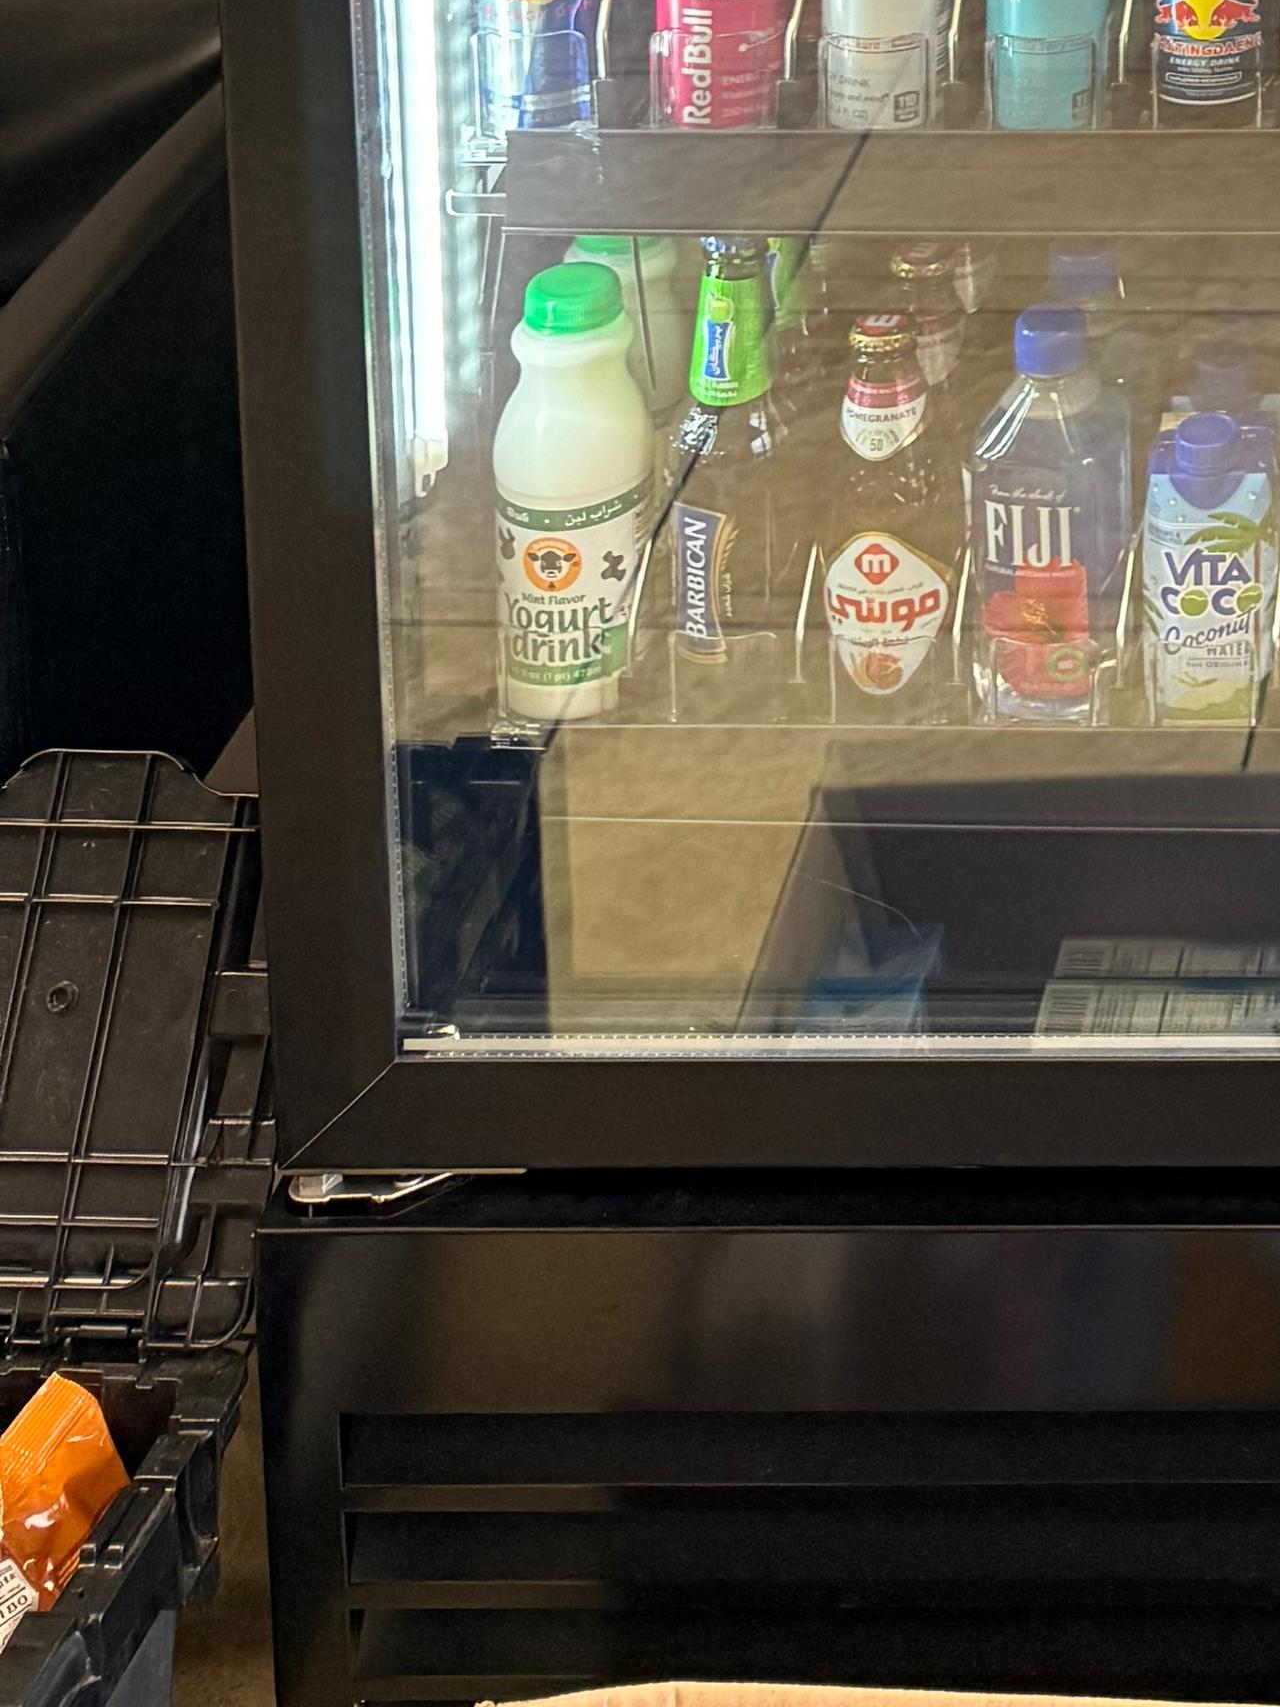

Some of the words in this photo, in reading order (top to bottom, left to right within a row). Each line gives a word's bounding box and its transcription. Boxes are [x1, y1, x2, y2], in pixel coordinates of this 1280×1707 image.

[870, 437, 884, 452] 50
[985, 499, 1073, 568] FIJI
[685, 517, 708, 640] BARBICAN
[1164, 548, 1252, 586] VITA
[504, 592, 613, 637] Yogurt
[548, 593, 586, 606] Flavor
[1161, 583, 1263, 617] COCO
